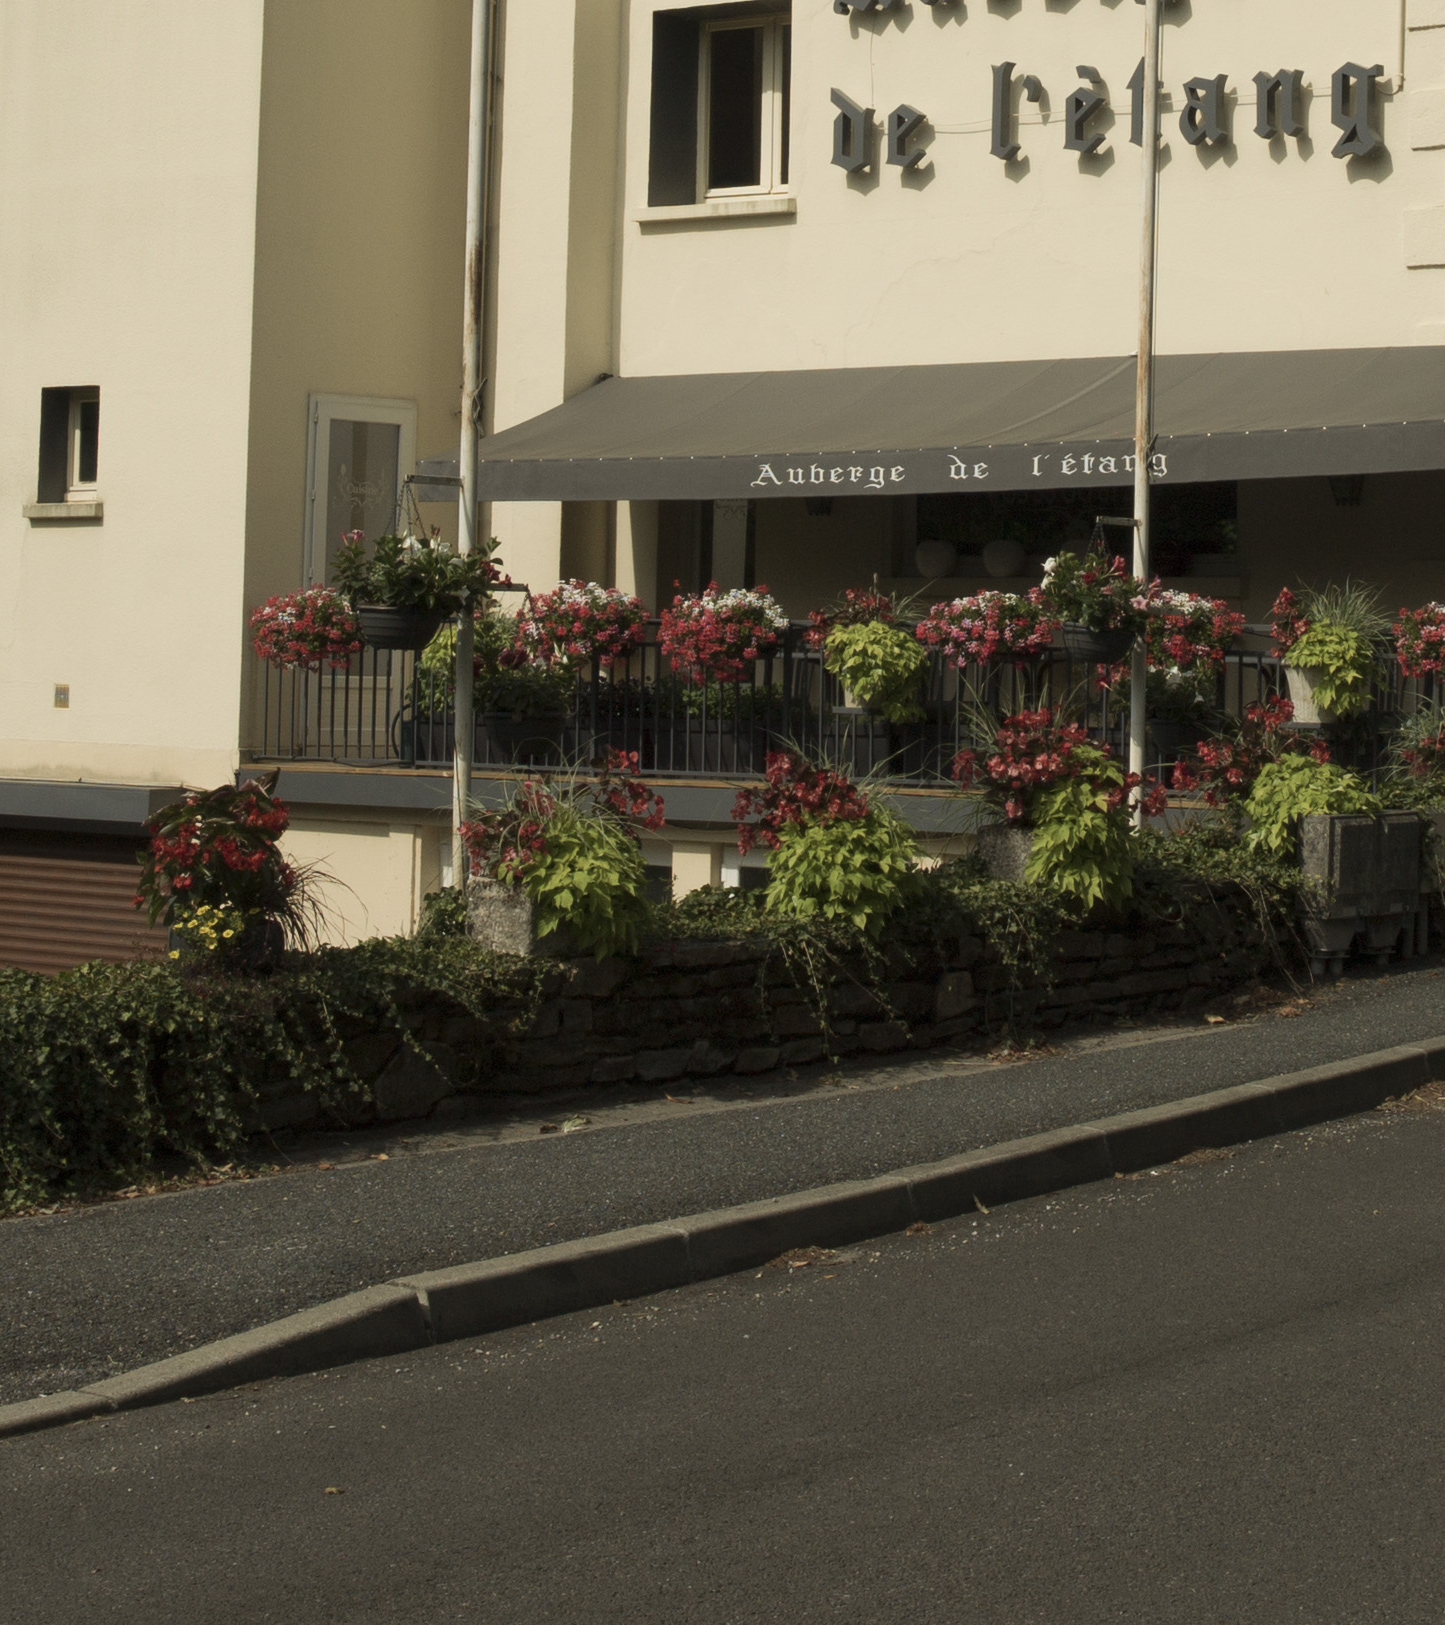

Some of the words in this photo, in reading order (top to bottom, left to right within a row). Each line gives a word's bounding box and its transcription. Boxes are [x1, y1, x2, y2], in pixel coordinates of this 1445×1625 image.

[830, 87, 928, 173] de
[750, 461, 906, 489] Auberge
[948, 454, 989, 480] de
